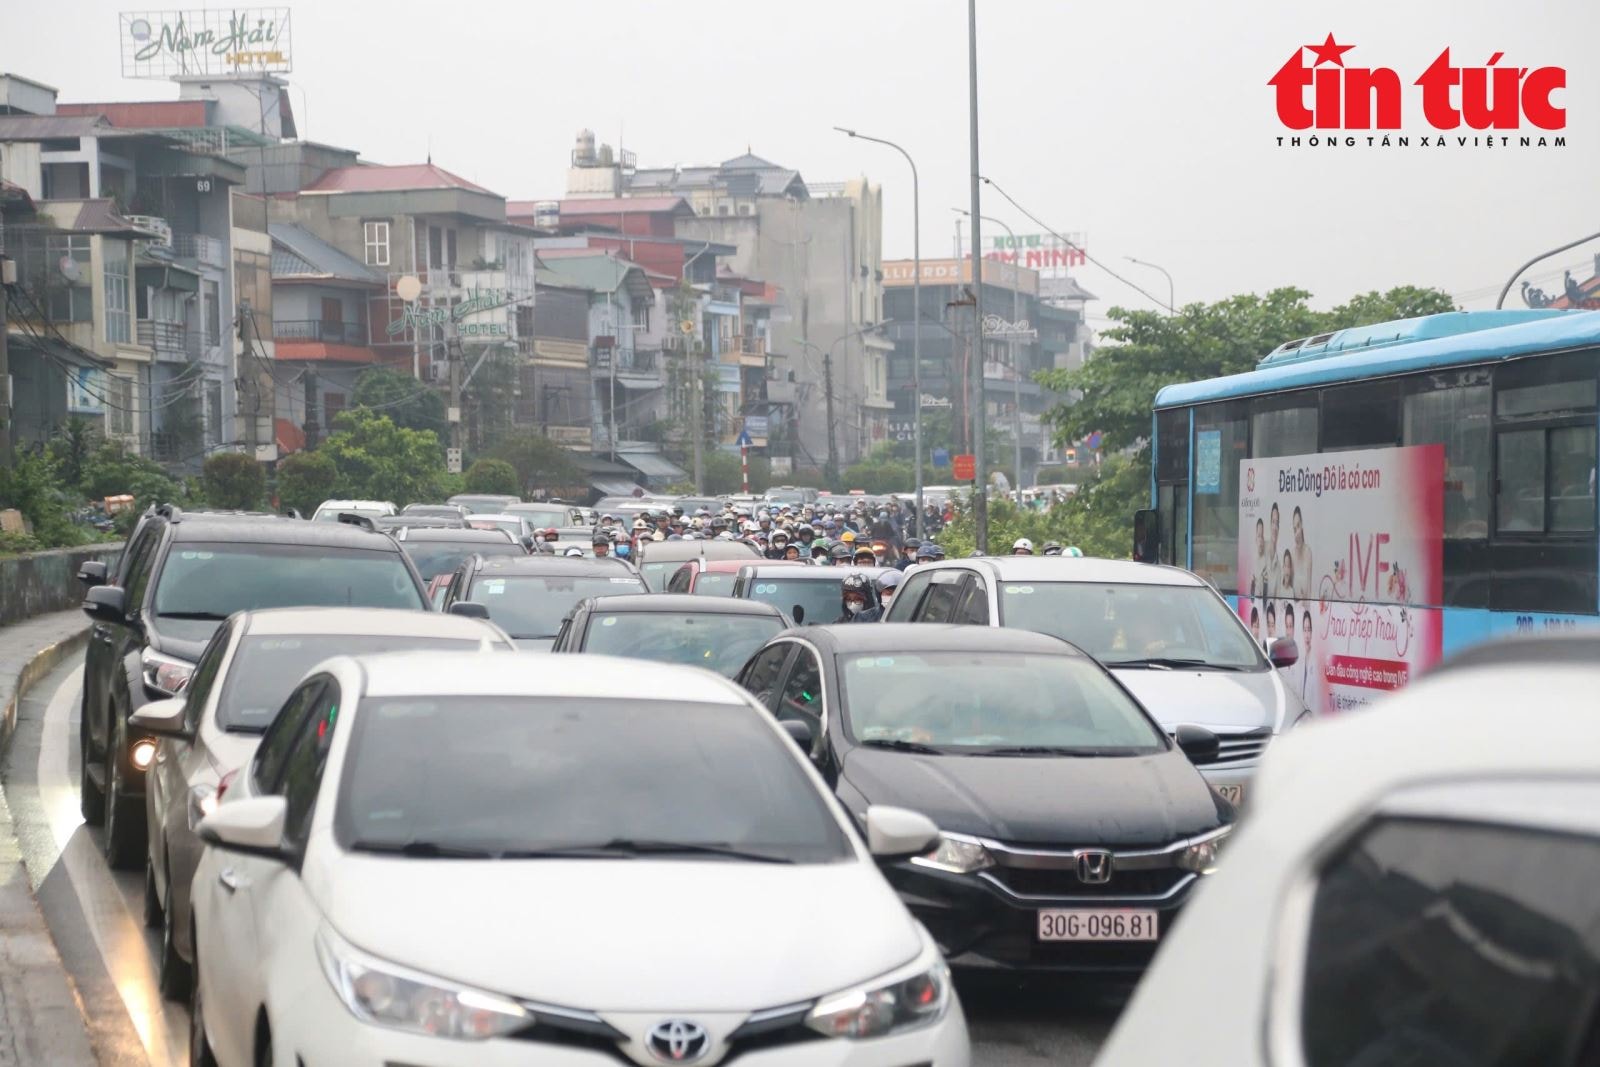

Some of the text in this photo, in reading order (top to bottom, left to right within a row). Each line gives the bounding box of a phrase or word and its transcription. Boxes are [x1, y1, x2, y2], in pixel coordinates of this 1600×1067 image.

[135, 19, 215, 60] Nam
[226, 51, 289, 65] HOTEL
[197, 180, 210, 192] 69
[386, 304, 449, 336] Nam
[457, 323, 506, 335] HOTEL
[1279, 463, 1381, 498] Đến Đông Đô là có con
[1349, 532, 1390, 599] IVF
[1042, 914, 1153, 938] 30G-096.81
